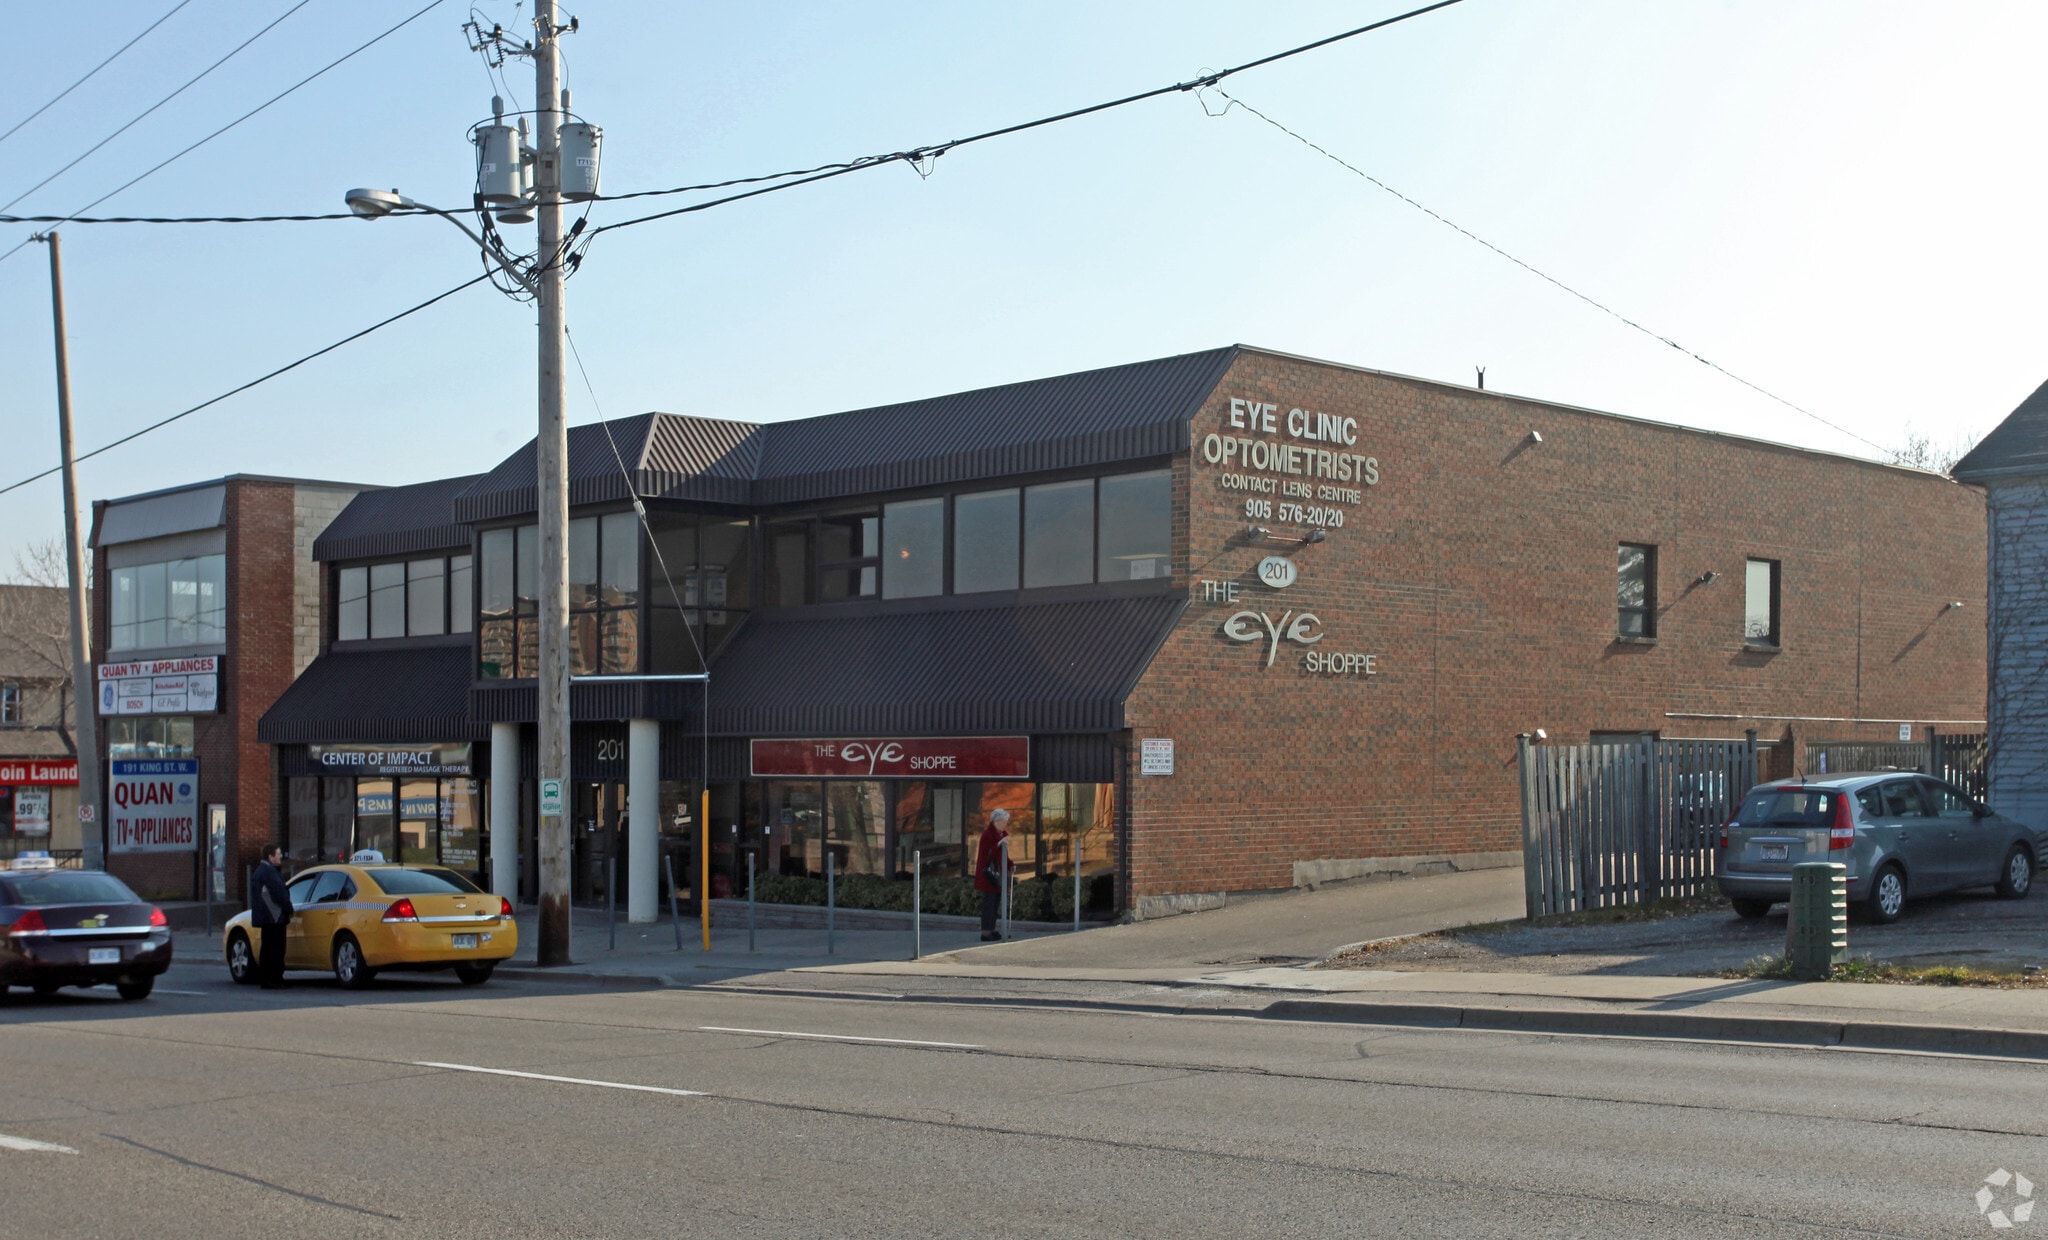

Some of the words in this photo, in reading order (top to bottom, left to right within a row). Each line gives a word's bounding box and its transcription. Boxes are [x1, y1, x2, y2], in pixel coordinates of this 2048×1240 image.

[1230, 398, 1277, 433] EYE
[1288, 408, 1357, 446] CLINIC
[1204, 433, 1379, 486] OPTOMETRISTS
[1221, 473, 1277, 494] CONTACT
[1282, 481, 1312, 499] LENS
[1317, 485, 1361, 505] CENTRE
[1245, 499, 1271, 519] 905
[1278, 503, 1344, 528] 576-20/20
[1265, 562, 1288, 580] 201
[1201, 580, 1240, 603] THE
[102, 665, 127, 678] QUAN
[130, 664, 142, 675] TV
[152, 658, 214, 674] APPLIANCES
[1306, 651, 1377, 675] SHOPPE
[126, 700, 144, 710] BOSCH
[322, 752, 365, 765] CENTER
[368, 752, 384, 765] OF
[387, 752, 432, 765] IMPACT
[598, 739, 624, 760] 201
[815, 745, 835, 757] THE
[910, 756, 956, 769] SHOPPE
[123, 764, 137, 773] 191
[139, 763, 162, 772] KING
[164, 763, 176, 772] ST.
[178, 763, 188, 772] W.
[114, 782, 173, 810] QUAN
[117, 818, 129, 845] TV
[134, 817, 192, 844] APPLIANCES
